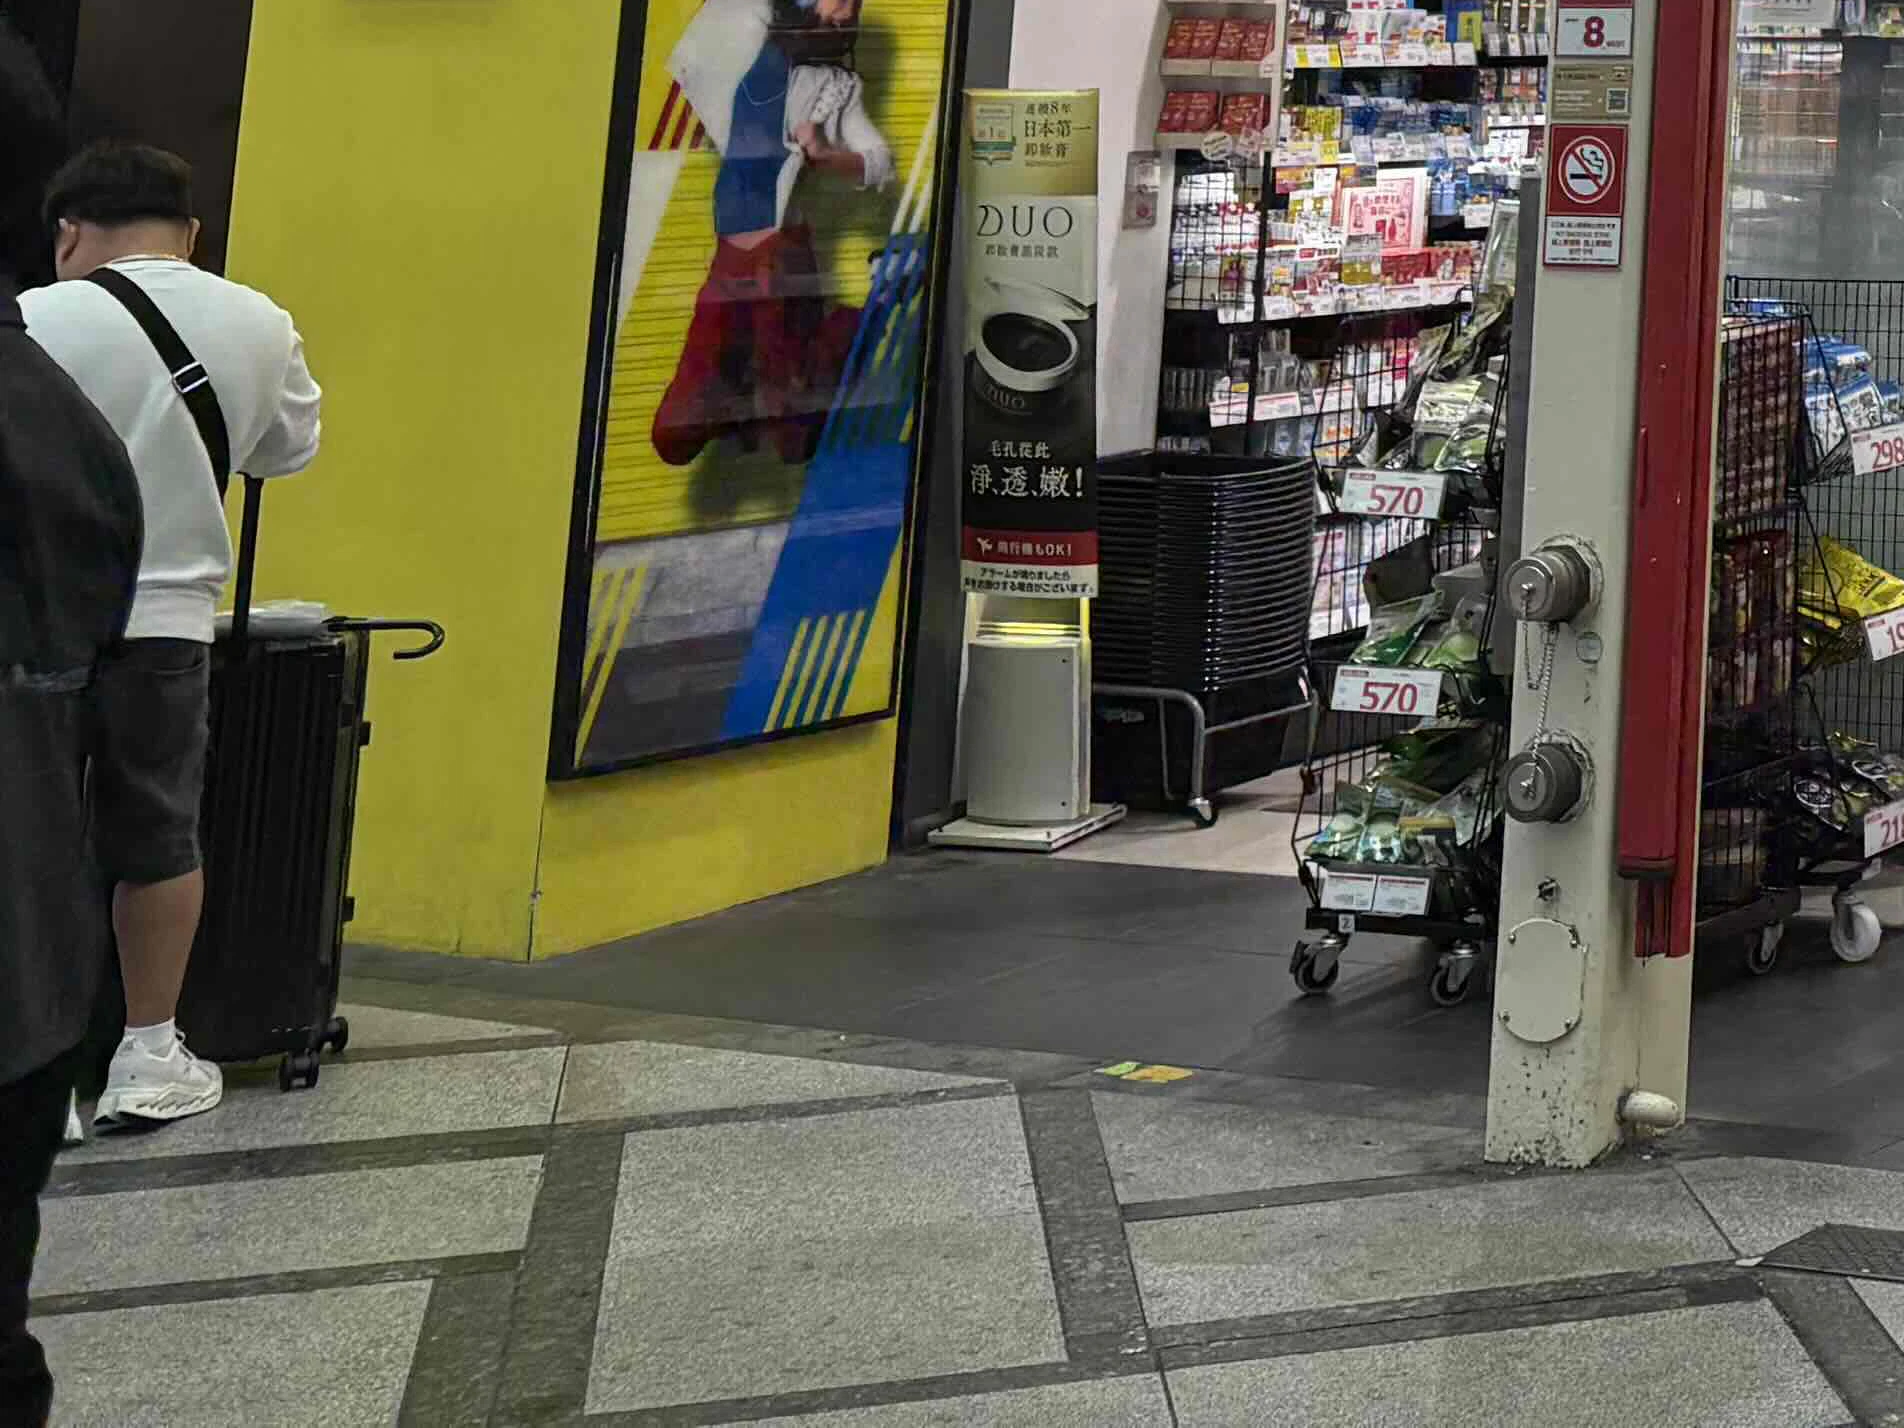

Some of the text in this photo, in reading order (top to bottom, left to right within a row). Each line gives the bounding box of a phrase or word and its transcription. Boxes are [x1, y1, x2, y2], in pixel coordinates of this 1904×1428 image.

[1584, 16, 1605, 48] 8
[1024, 119, 1092, 139] 日本第一
[976, 204, 1074, 239] DUO
[1367, 483, 1425, 517] 570
[1358, 680, 1419, 715] 570
